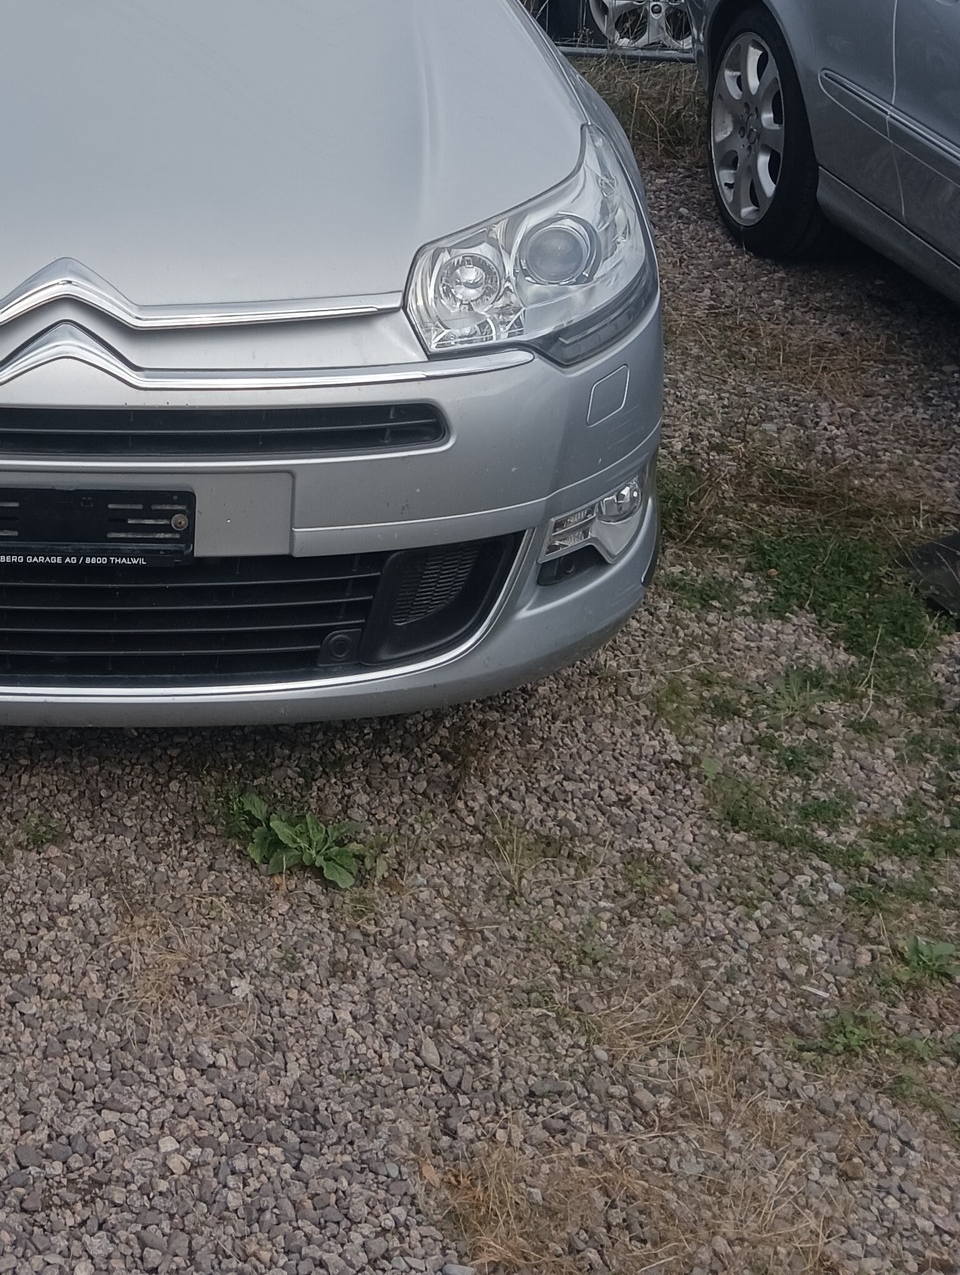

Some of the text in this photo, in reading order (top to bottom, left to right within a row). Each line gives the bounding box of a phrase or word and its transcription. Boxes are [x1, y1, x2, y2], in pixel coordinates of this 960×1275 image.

[26, 556, 62, 565] GARAGE
[64, 556, 77, 565] AG
[85, 557, 108, 565] 8800
[110, 557, 147, 566] THALWIL
